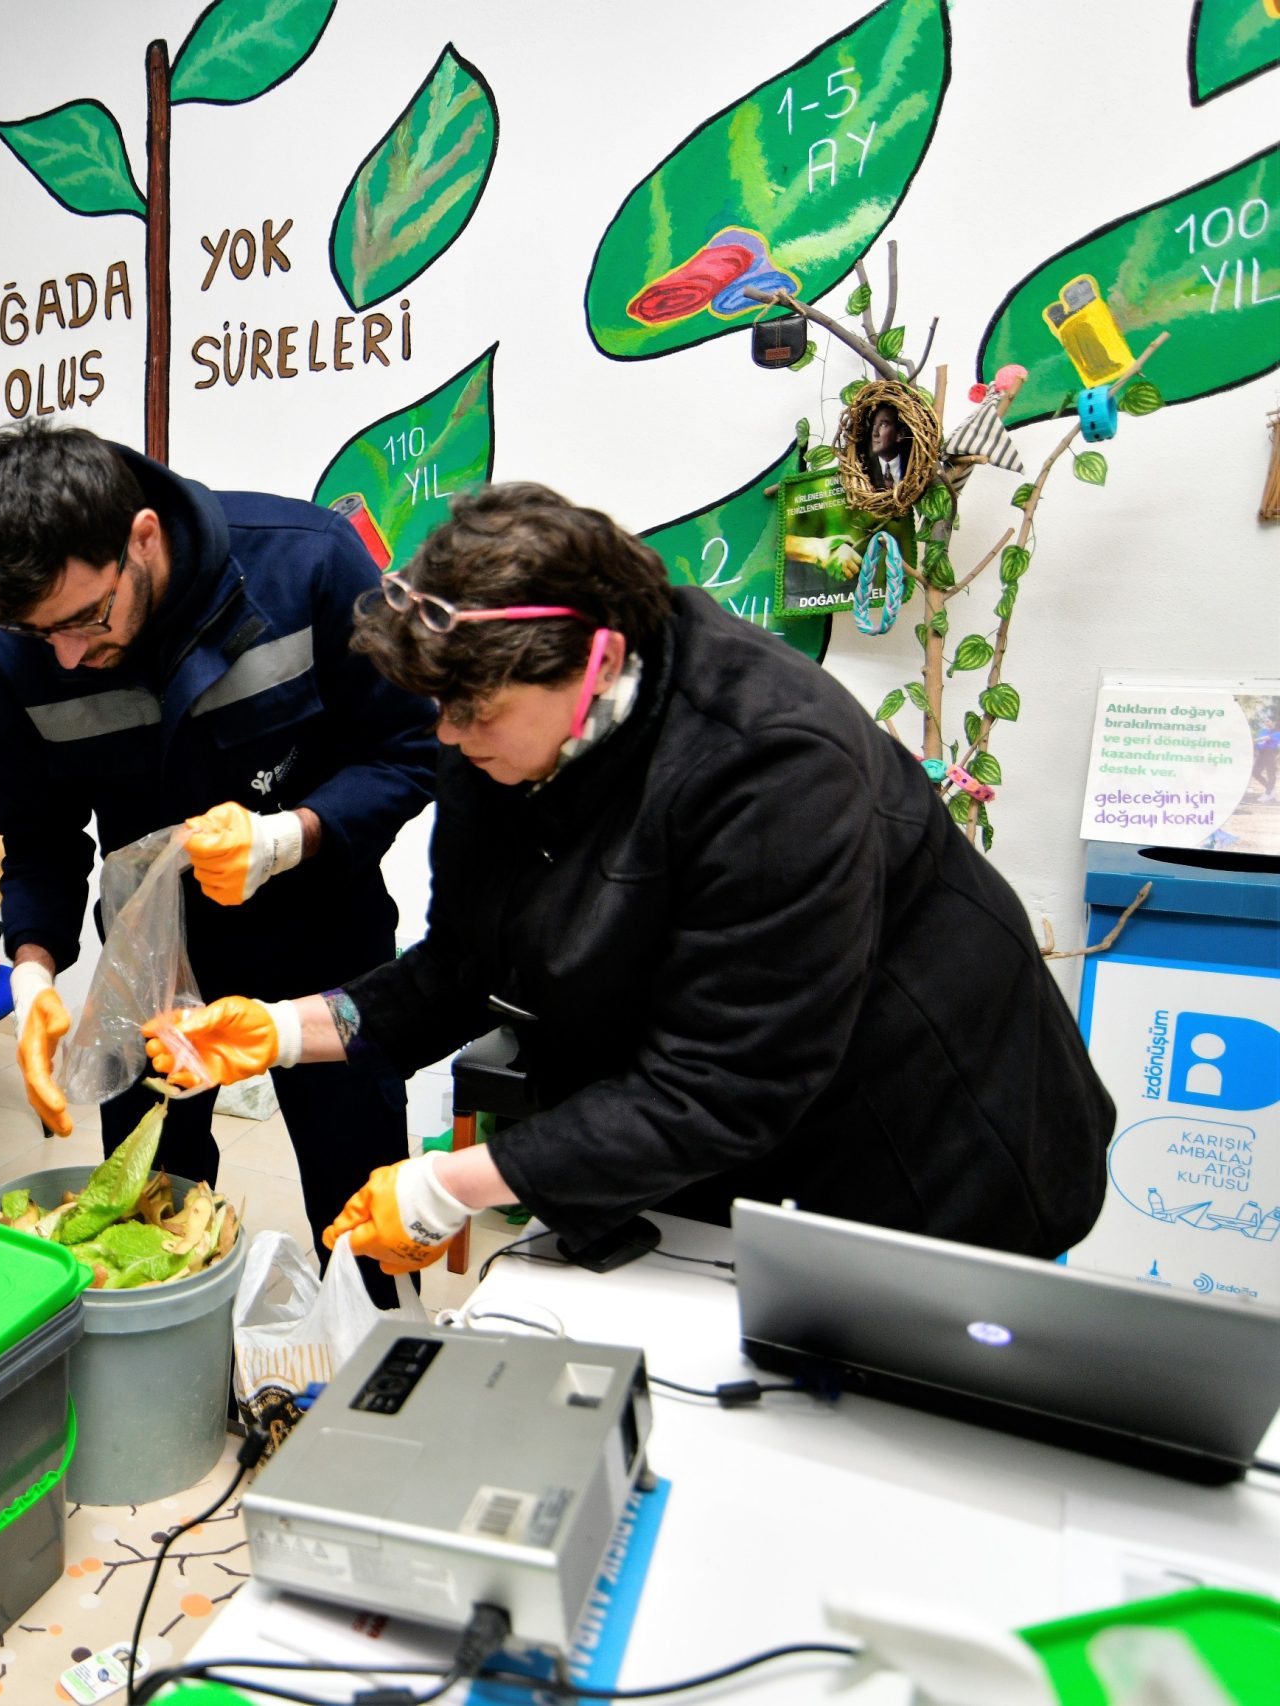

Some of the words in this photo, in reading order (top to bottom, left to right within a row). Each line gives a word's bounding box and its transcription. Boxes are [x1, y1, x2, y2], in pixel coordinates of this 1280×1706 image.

[776, 66, 858, 136] 1-5
[808, 120, 877, 195] AY
[1174, 197, 1270, 255] 100
[200, 218, 294, 292] YOK
[1200, 256, 1280, 314] YIL
[4, 349, 105, 420] OLUŞ
[191, 298, 412, 390] SÜRELERİ
[383, 426, 425, 466] 110
[403, 463, 455, 506] YIL
[700, 536, 743, 588] 2
[799, 588, 855, 608] DOĞAYLA
[1105, 702, 1167, 715] Atıkların
[1169, 705, 1225, 719] doğaya
[1103, 734, 1121, 744] ve
[1122, 734, 1152, 747] geri
[1153, 734, 1232, 750] dönüşüme
[1098, 762, 1147, 775] destek
[1207, 754, 1233, 766] için
[1094, 789, 1181, 809] geleceğin
[1185, 791, 1216, 809] için
[1094, 809, 1158, 828] doğayı
[1141, 1009, 1170, 1100] izdönüşüm
[1181, 1131, 1253, 1153] KARIŞIK
[1166, 1143, 1253, 1166] AMBALAJ
[1177, 1170, 1250, 1192] KUTUSU
[1204, 1162, 1251, 1179] ATIĞI
